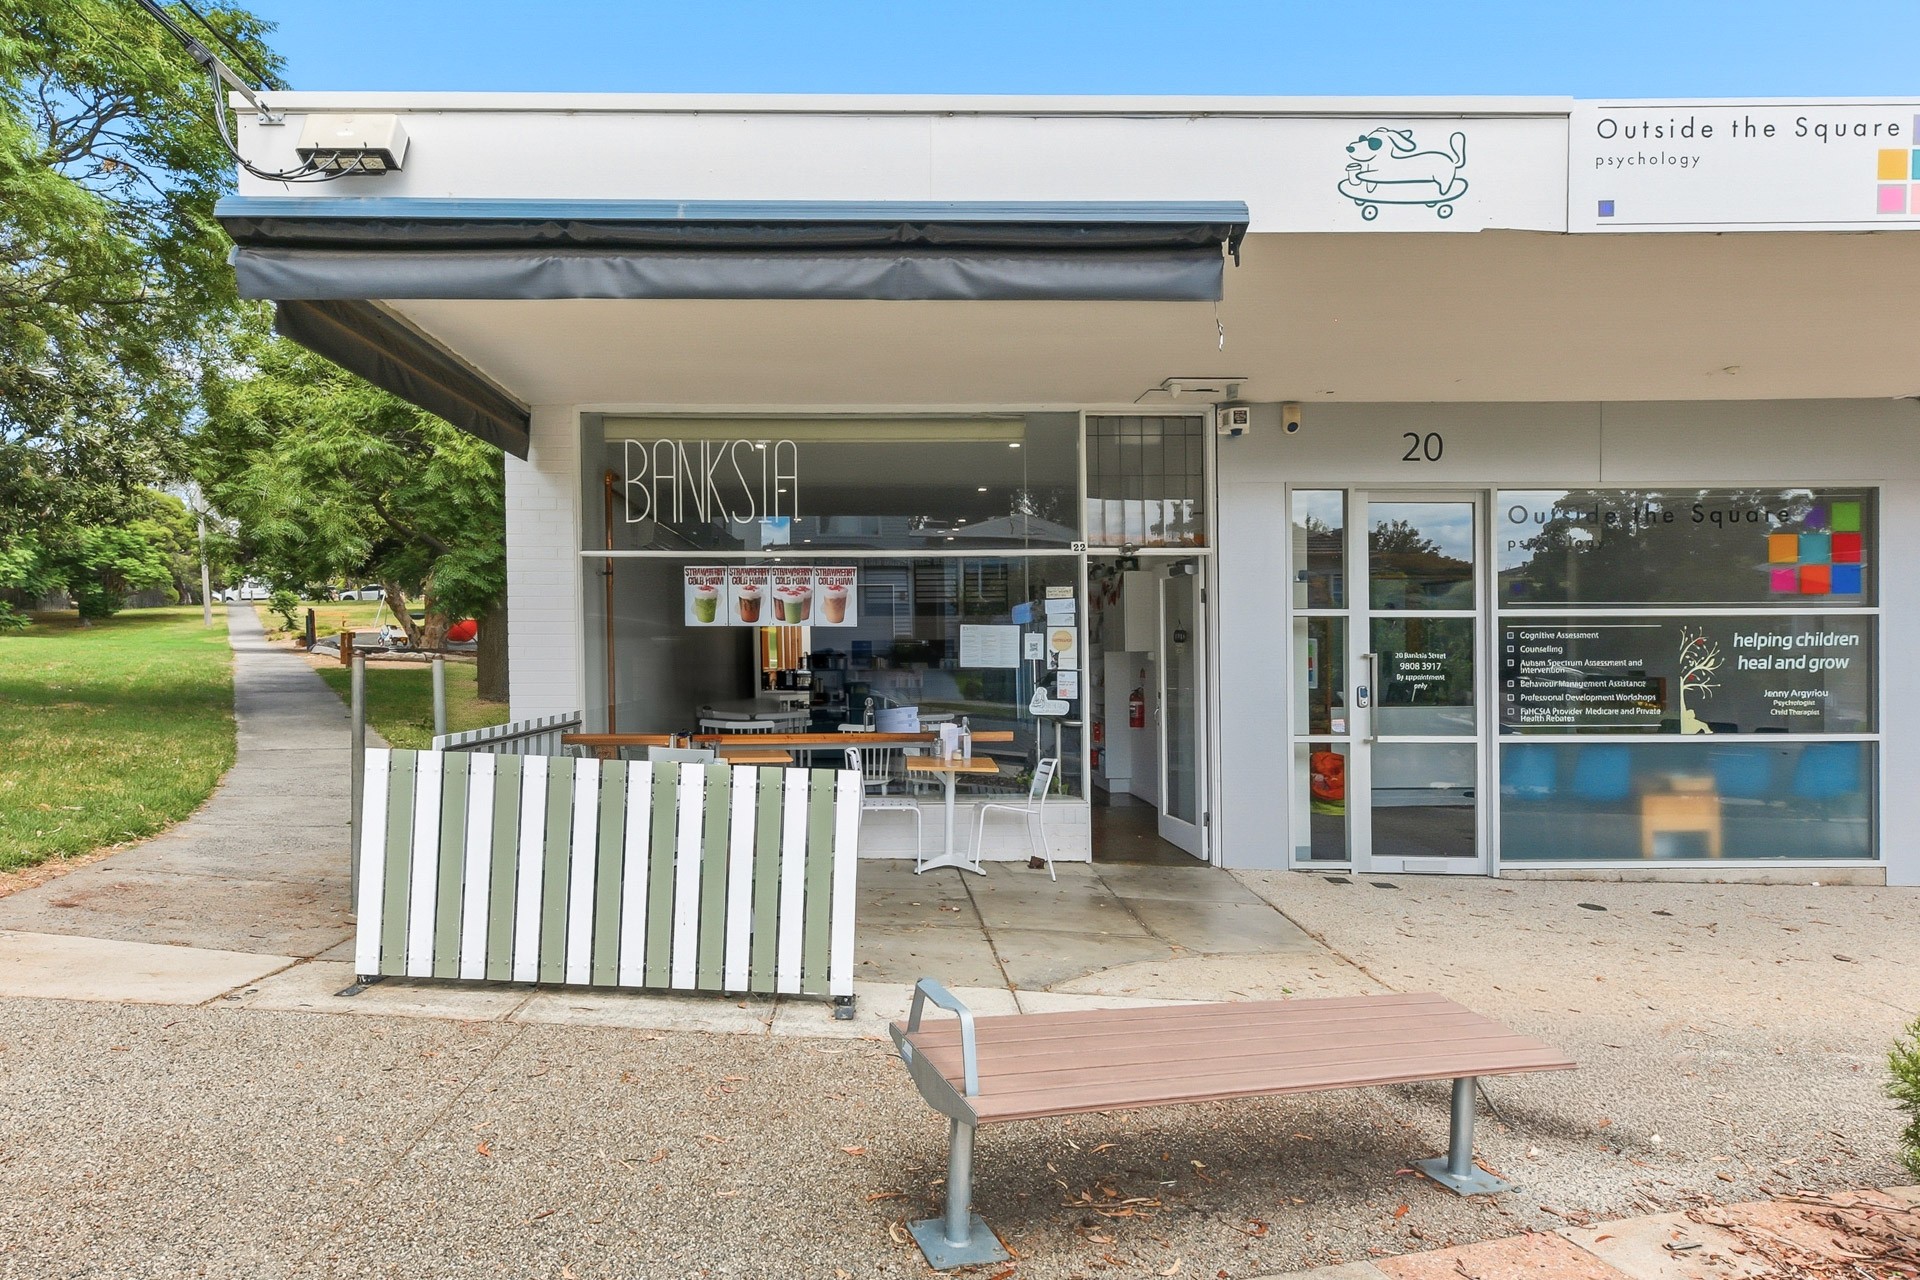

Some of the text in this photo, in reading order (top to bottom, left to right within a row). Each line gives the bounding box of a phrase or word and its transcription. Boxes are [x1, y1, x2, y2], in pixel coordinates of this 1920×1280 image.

[1597, 115, 1900, 144] Outside the Square
[1595, 152, 1701, 169] psychology
[1402, 432, 1443, 462] 20
[624, 438, 798, 524] BANKSIA
[1691, 503, 1790, 528] Square
[1073, 543, 1086, 552] 22
[1508, 536, 1606, 552] pslogy
[1520, 631, 1599, 640] Cognitive Assessment
[1733, 631, 1859, 650] helping children
[1399, 662, 1442, 670] 9808 3917
[1520, 659, 1643, 668] Autism Spectrum Assessment and
[1738, 655, 1850, 673] heal and grow
[1520, 666, 1565, 674] Intervention
[1396, 674, 1445, 682] By appointment
[1520, 680, 1558, 688] Behaviour
[1608, 680, 1646, 688] Assistance
[1565, 694, 1615, 703] Development
[1616, 694, 1657, 702] Workshops
[1764, 690, 1789, 699] Jenny
[1773, 700, 1816, 708] Psychologist
[1770, 708, 1820, 716] Child Therapist
[1520, 714, 1575, 722] Health Rebates
